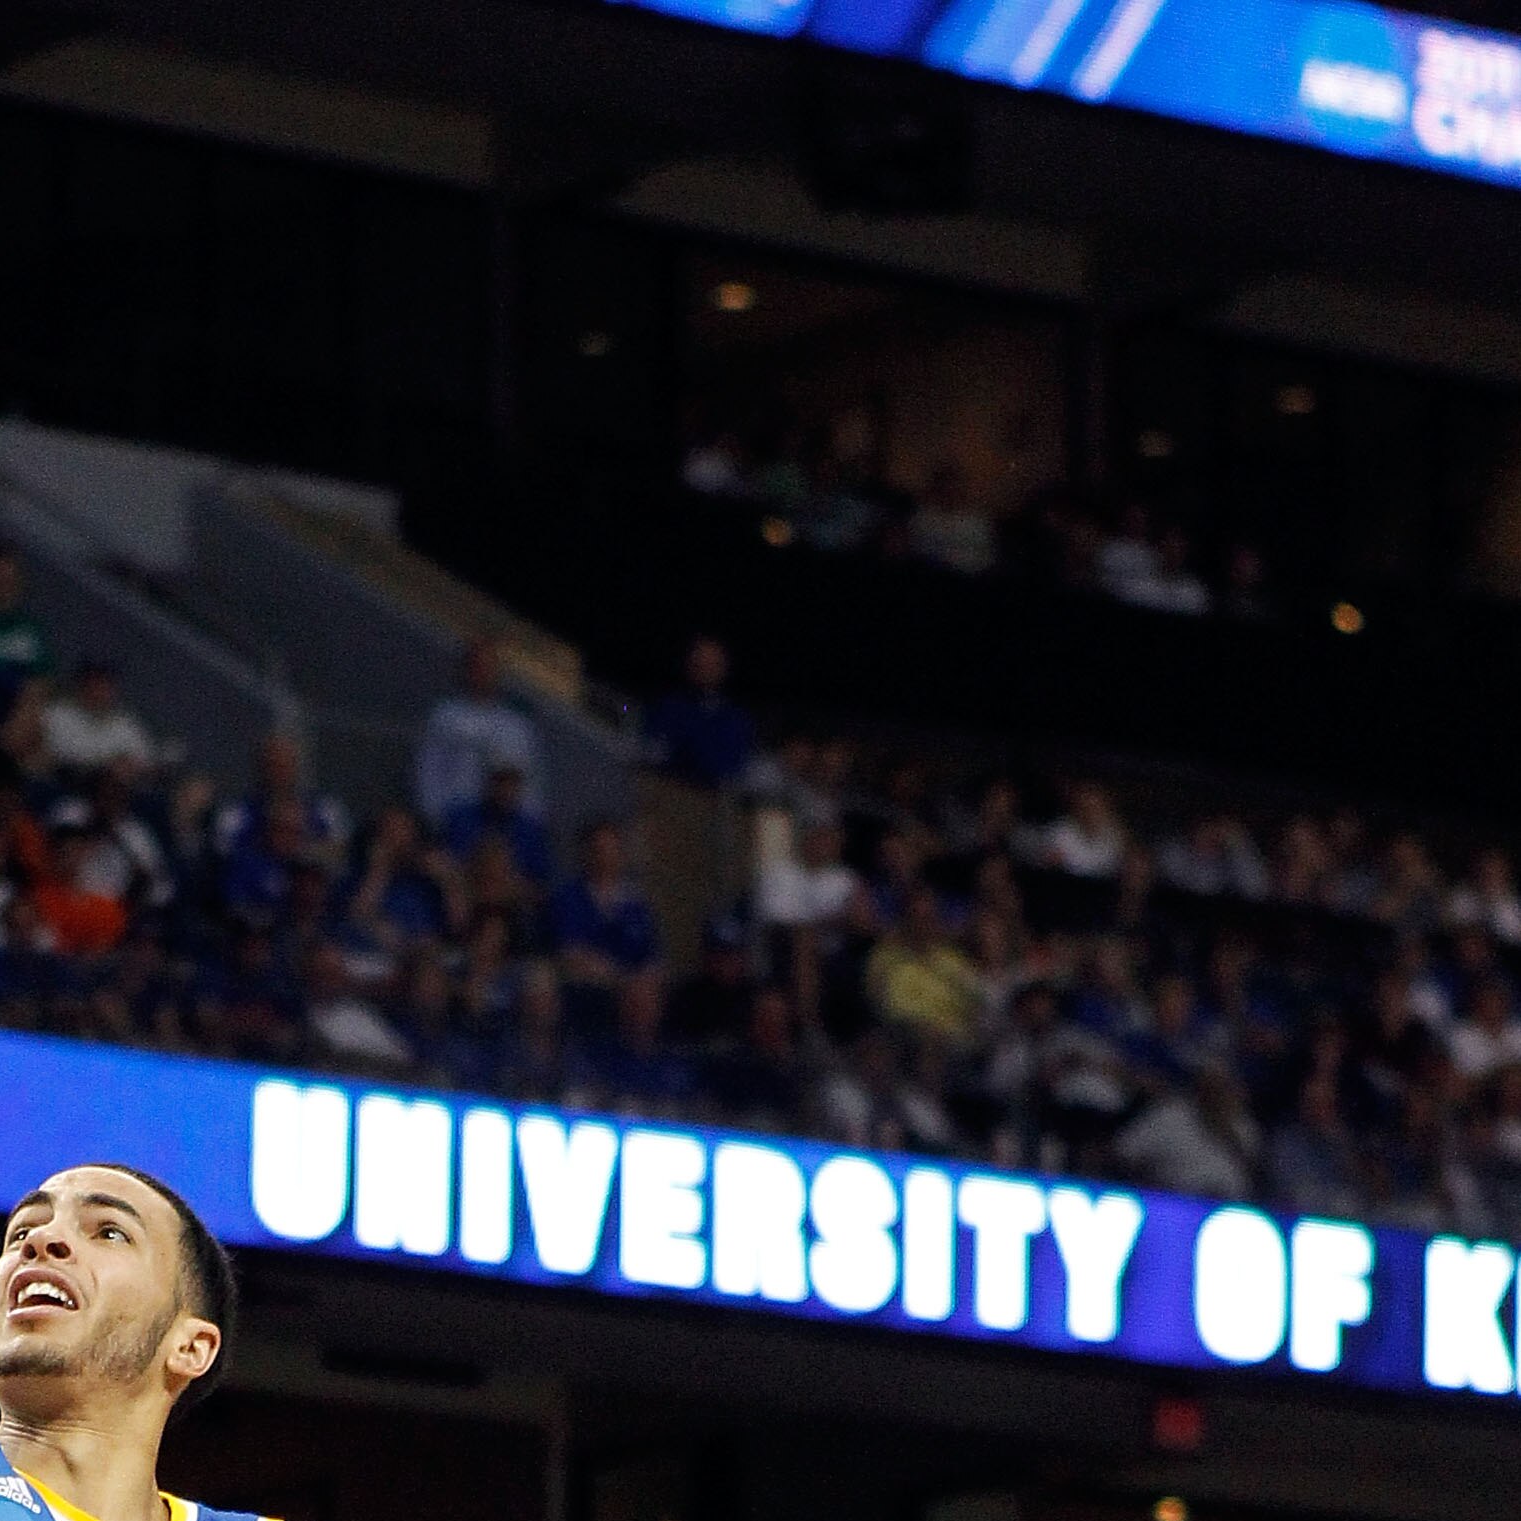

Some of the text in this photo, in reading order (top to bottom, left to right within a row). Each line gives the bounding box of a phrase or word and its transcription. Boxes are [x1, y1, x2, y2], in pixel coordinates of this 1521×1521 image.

[253, 1081, 1521, 1394] UNIVERSITY OF K
